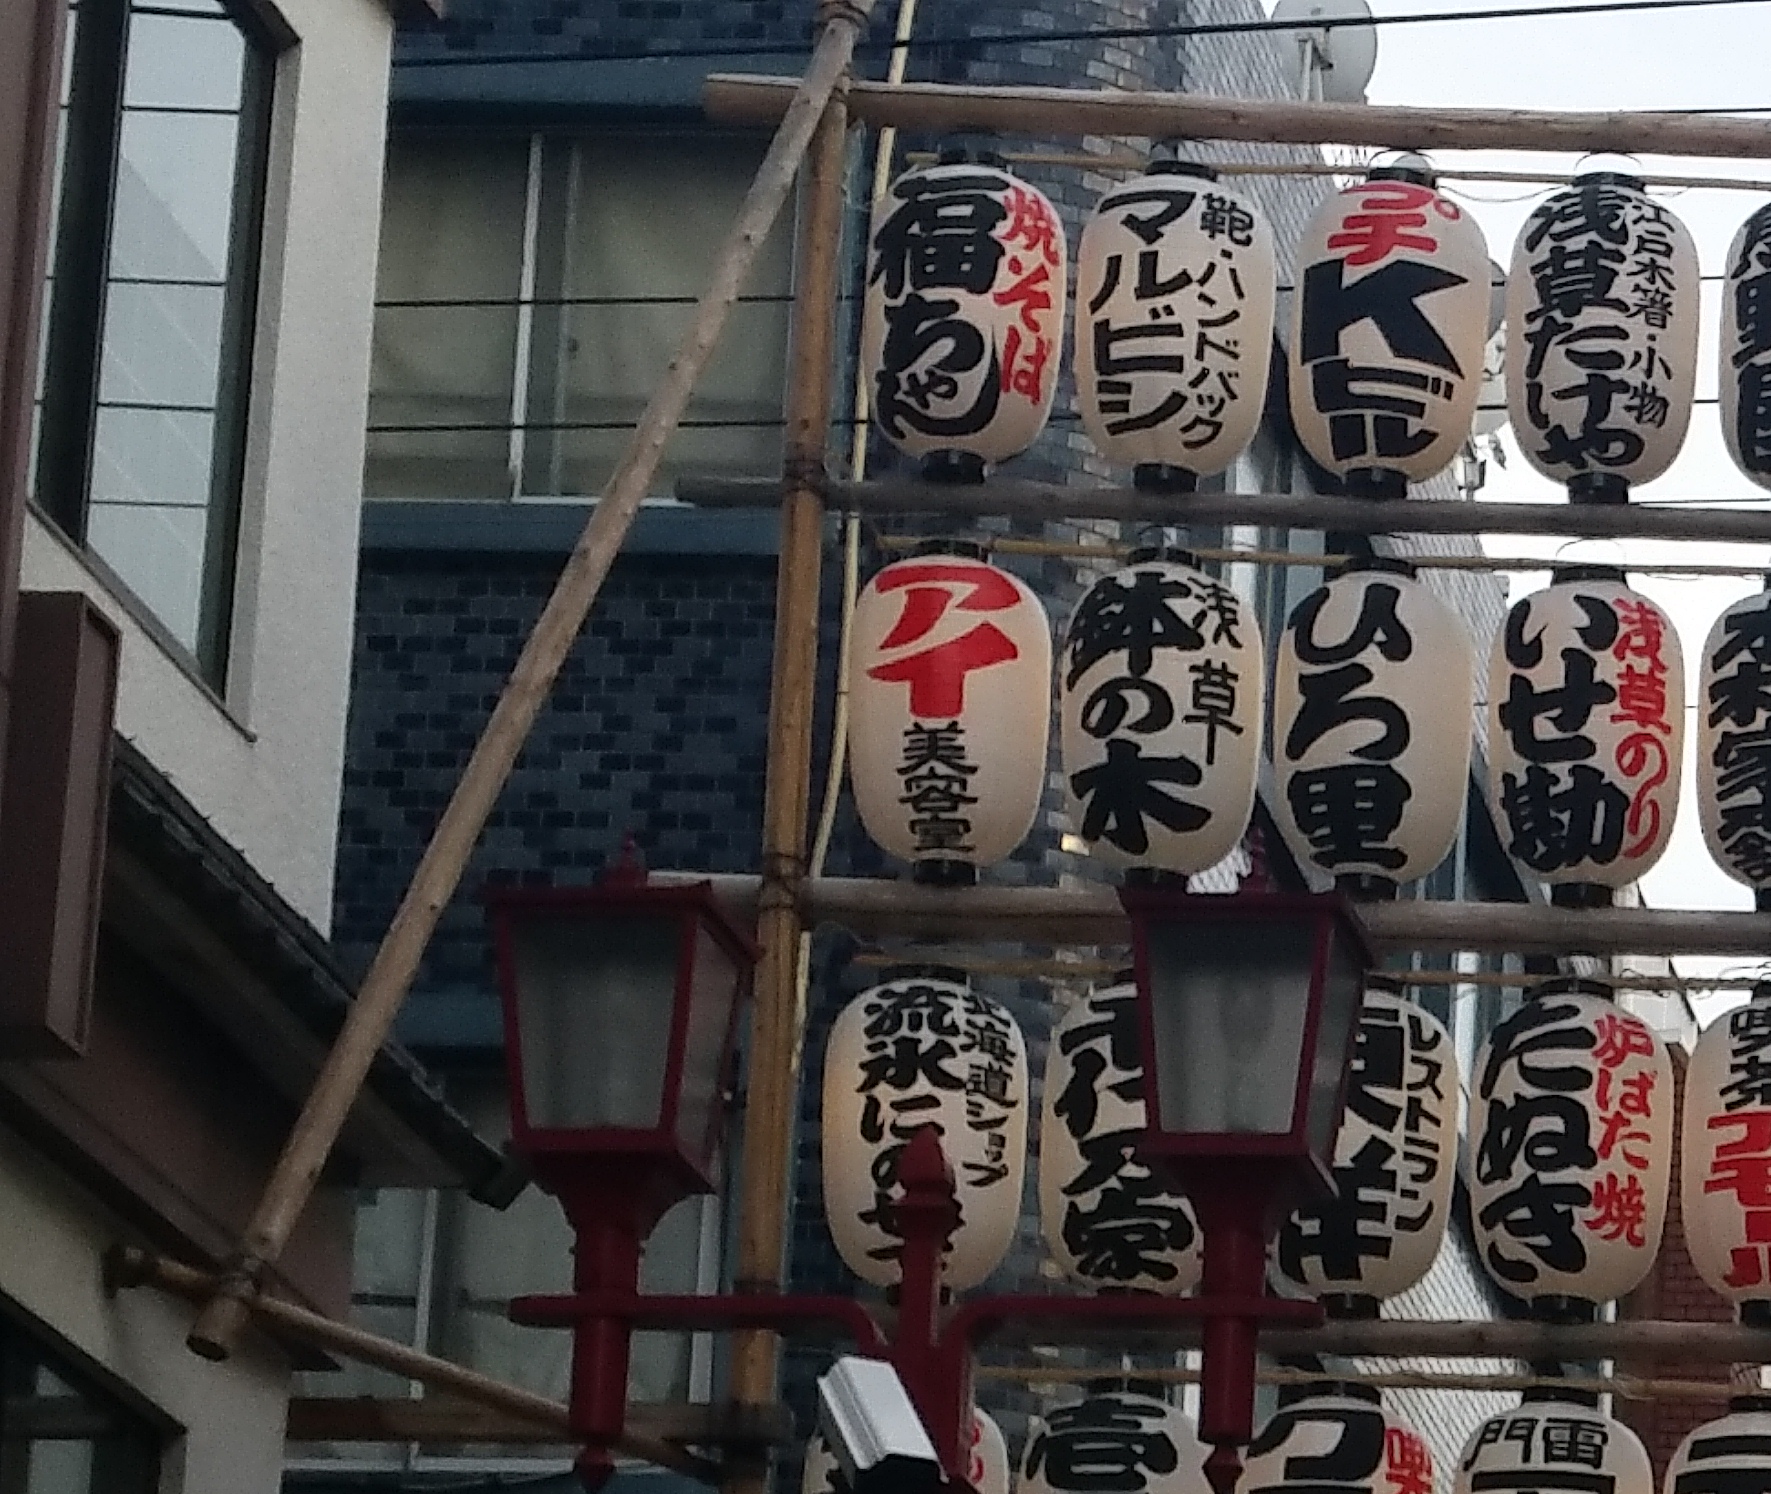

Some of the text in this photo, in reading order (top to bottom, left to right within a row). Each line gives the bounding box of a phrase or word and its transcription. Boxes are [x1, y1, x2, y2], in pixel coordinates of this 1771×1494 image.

[995, 191, 1061, 405] 焼そば
[1526, 185, 1644, 470] 浅草たけや
[1622, 192, 1675, 428] 江戸木箸・小物
[871, 566, 1023, 720] アイ
[1066, 573, 1211, 852] 鉢の木
[1183, 578, 1244, 765] 浅草
[1285, 586, 1412, 870] ひろ里
[1612, 602, 1674, 857] 浅草のり
[900, 722, 978, 852] 美容室
[1395, 1018, 1443, 1233] レストラン
[1478, 1000, 1598, 1286] たぬき
[1588, 1018, 1657, 1247] 炉ばた焼
